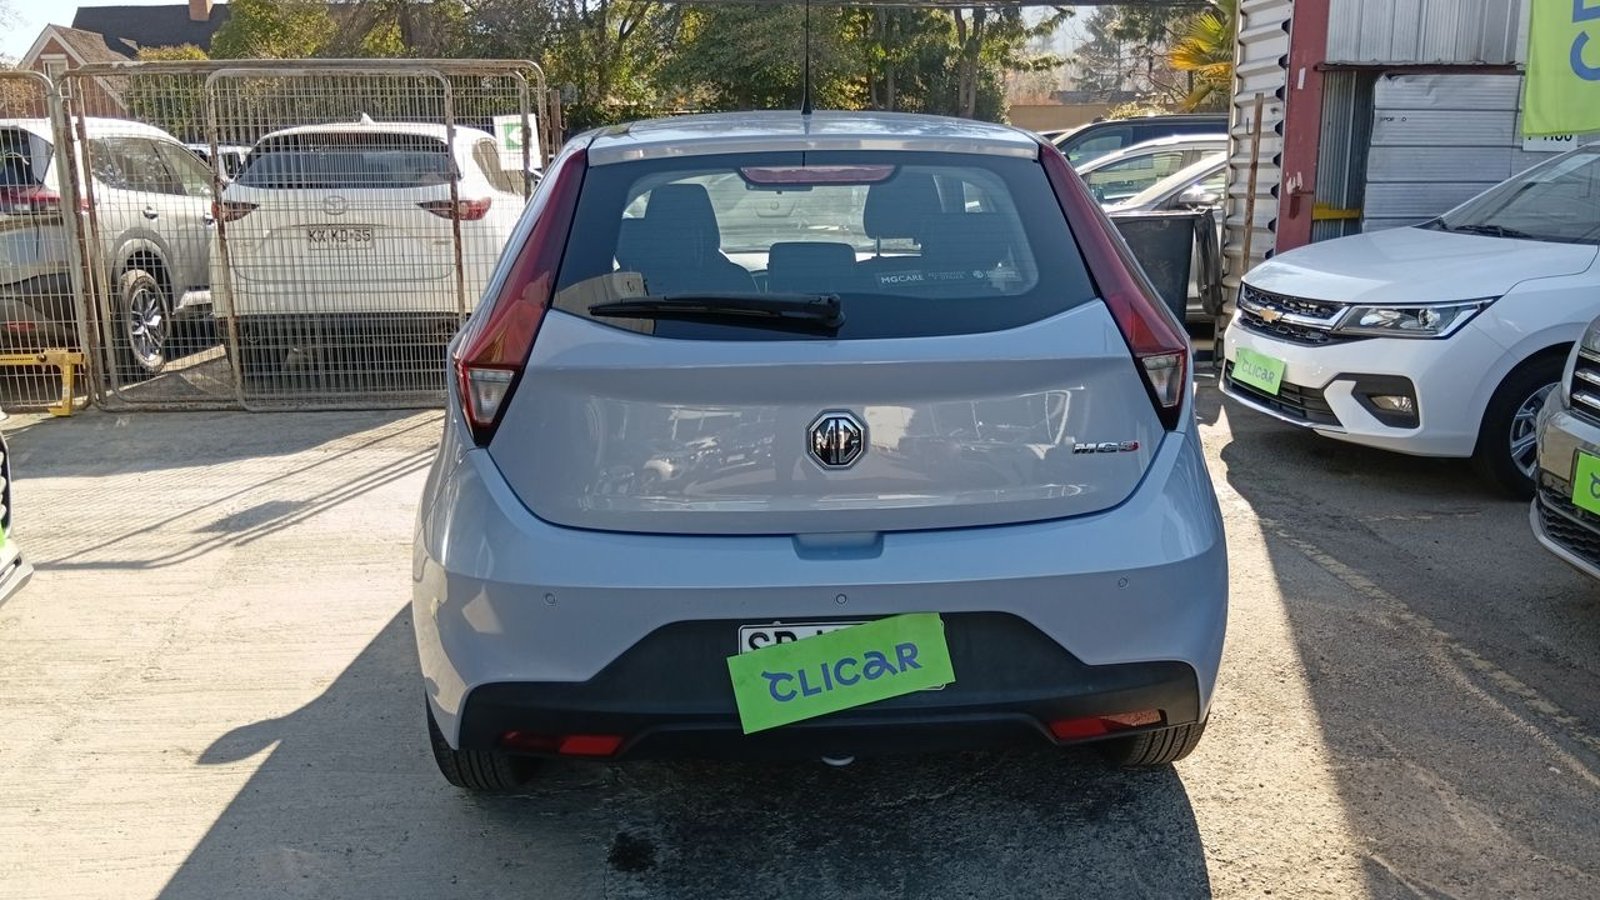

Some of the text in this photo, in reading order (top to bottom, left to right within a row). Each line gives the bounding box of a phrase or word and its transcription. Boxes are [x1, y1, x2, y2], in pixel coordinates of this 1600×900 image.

[880, 274, 925, 284] MGCARE
[813, 418, 861, 465] MG
[1073, 441, 1139, 454] MG3
